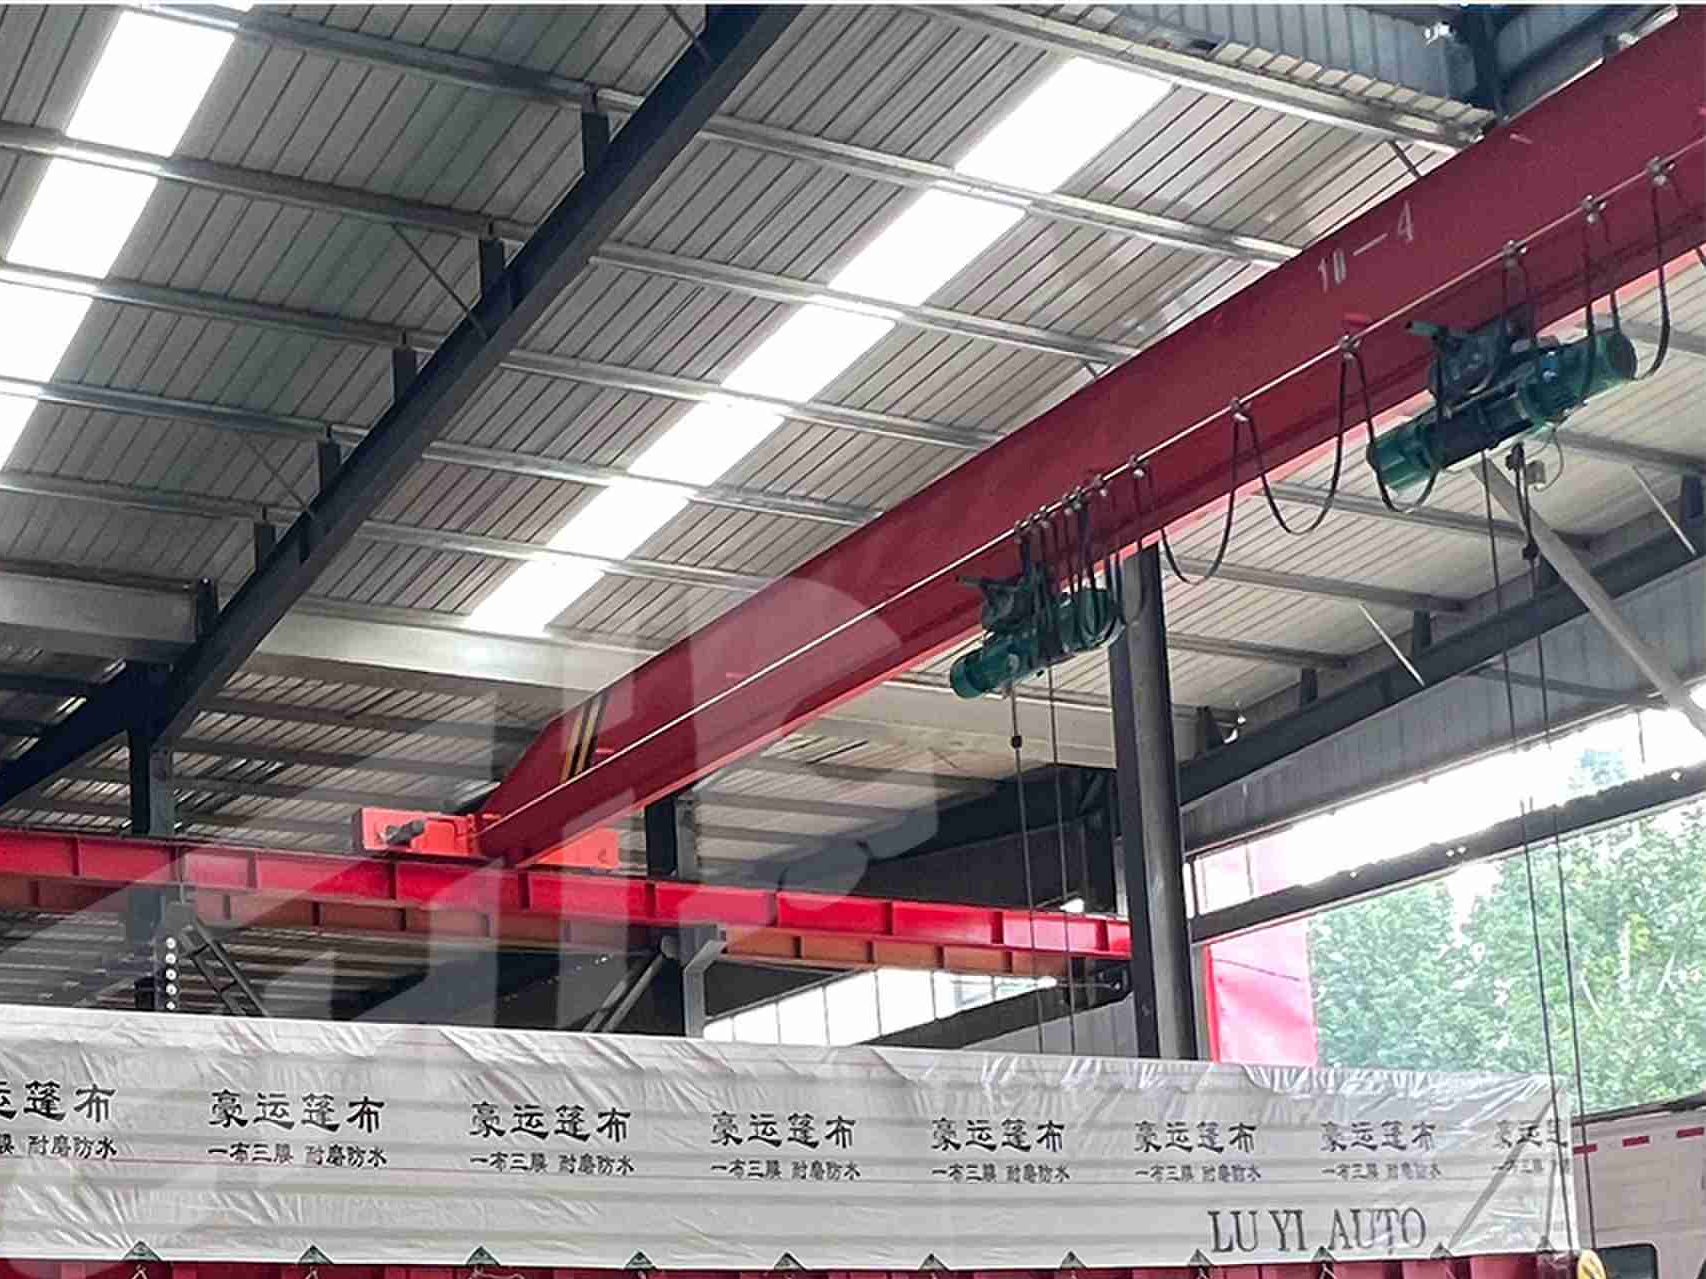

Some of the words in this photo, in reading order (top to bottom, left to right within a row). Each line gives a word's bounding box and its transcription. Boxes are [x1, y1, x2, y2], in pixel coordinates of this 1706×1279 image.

[210, 1089, 384, 1133] 豪运篷布
[470, 1102, 630, 1142] 豪运篷布
[712, 1111, 855, 1148] 豪运篷布
[28, 1134, 117, 1159] 耐磨防水
[933, 1118, 1064, 1152] 豪运篷布
[1208, 1210, 1258, 1253] LU
[1268, 1210, 1307, 1251] YI
[1326, 1208, 1427, 1252] AUTO
